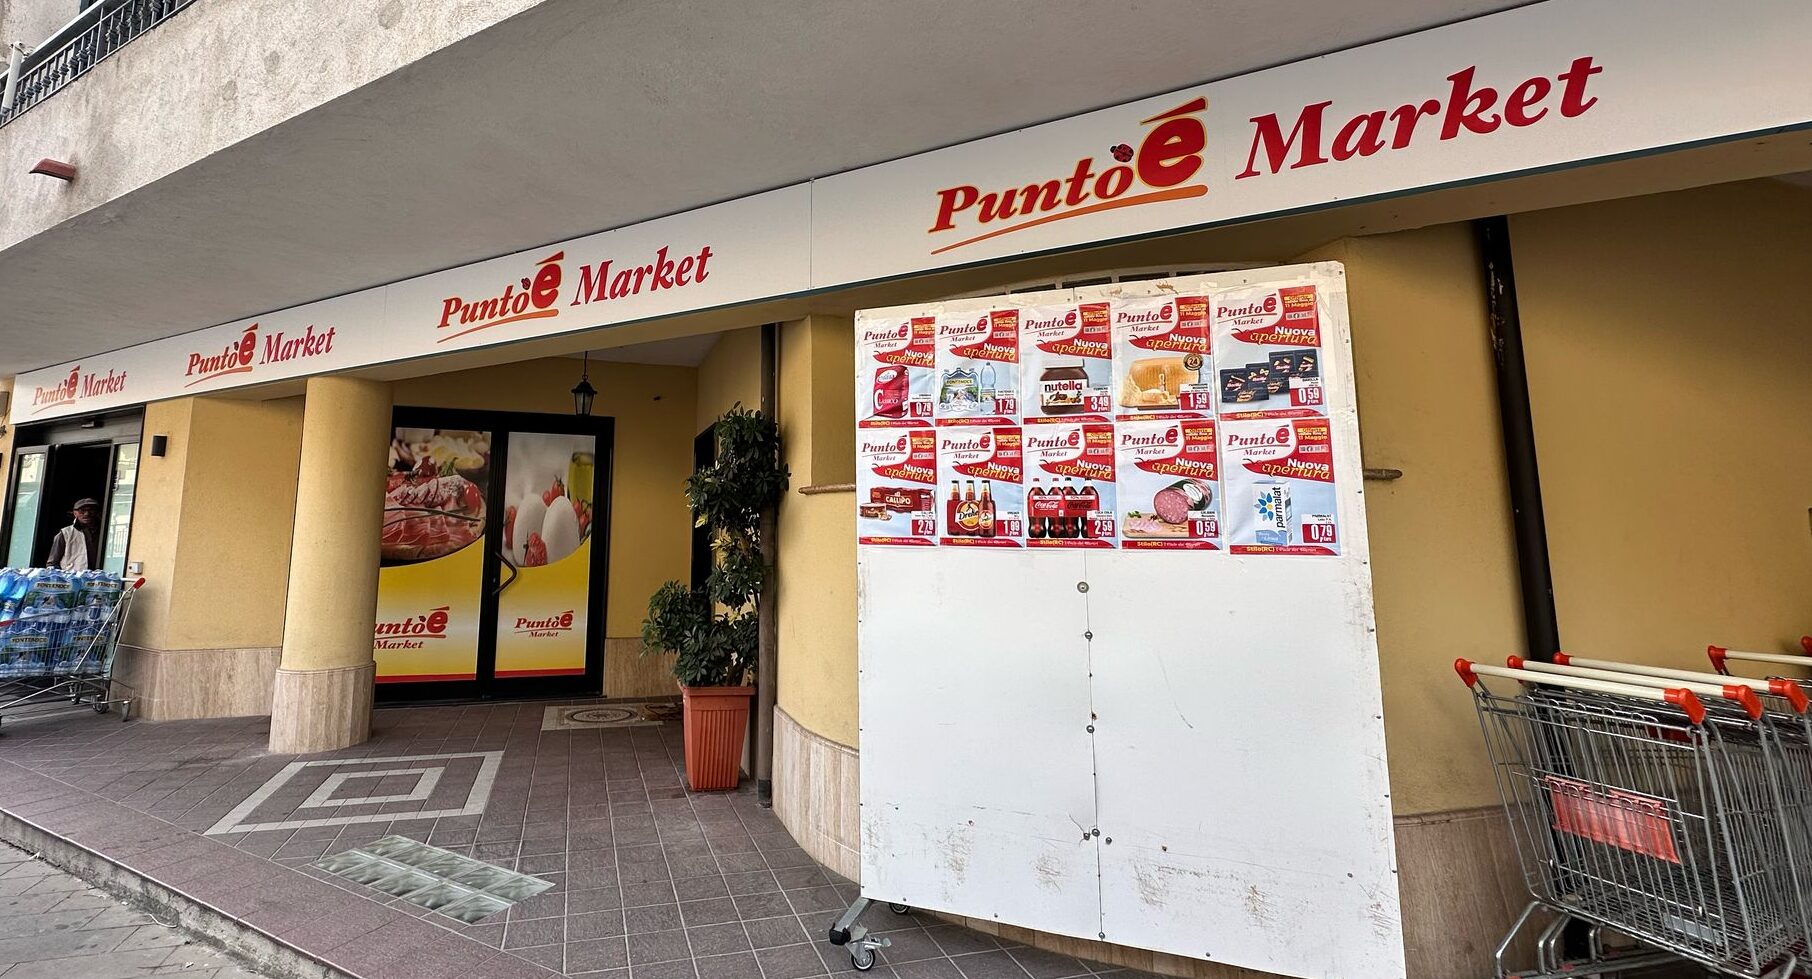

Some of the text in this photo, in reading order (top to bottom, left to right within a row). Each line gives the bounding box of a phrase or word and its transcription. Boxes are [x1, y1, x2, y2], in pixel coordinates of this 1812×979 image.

[1235, 56, 1603, 180] Market
[570, 246, 713, 308] Market
[1232, 318, 1263, 326] Market
[1275, 326, 1315, 335] Nuova
[1074, 339, 1108, 349] Nuova
[1170, 334, 1206, 343] Nuova
[1250, 333, 1316, 345] apertura
[260, 326, 336, 366] Market
[984, 343, 1015, 353] Nuova
[1052, 344, 1108, 356] apertura
[1146, 339, 1207, 351] apertura
[886, 355, 934, 365] apertura
[905, 350, 933, 358] Nuova
[964, 348, 1015, 360] apertura
[79, 369, 127, 400] Market
[1044, 381, 1082, 391] nutella
[904, 464, 933, 474] Nuova
[988, 462, 1019, 473] Nuova
[1077, 460, 1111, 471] Nuova
[1176, 458, 1213, 469] Nuova
[1287, 459, 1329, 471] Nuova
[885, 468, 934, 482] apertura
[968, 466, 1019, 480] apertura
[1055, 464, 1112, 479] apertura
[1152, 463, 1214, 477] apertura
[1262, 463, 1329, 480] apertura
[1272, 487, 1285, 528] parmalat
[373, 639, 424, 650] Market
